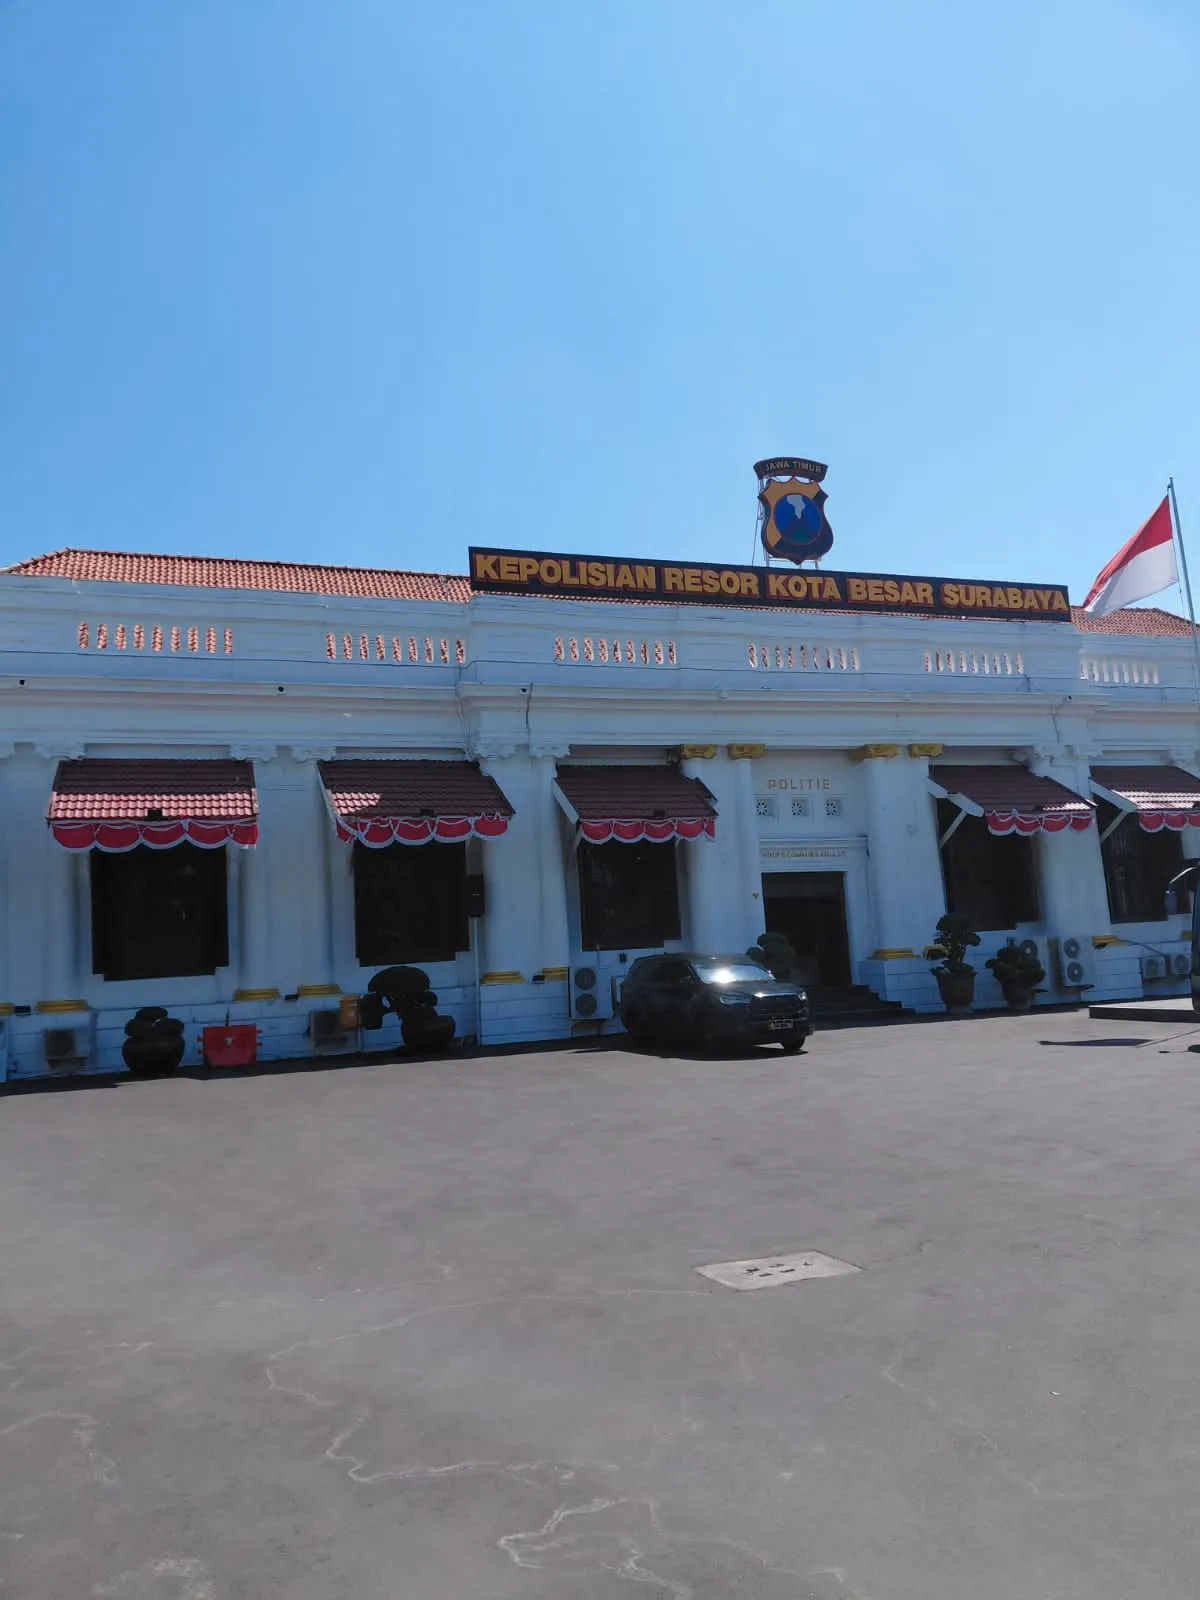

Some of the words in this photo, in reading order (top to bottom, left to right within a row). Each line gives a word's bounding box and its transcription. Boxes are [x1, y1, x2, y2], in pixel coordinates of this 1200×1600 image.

[765, 461, 789, 472] JAWA
[474, 553, 657, 591] KEPOLISIAN
[663, 567, 759, 597] RESOR
[767, 573, 841, 601] KOTA
[847, 578, 934, 606] BESAR
[942, 583, 1069, 612] SURABAYA
[767, 779, 831, 790] POLITIE
